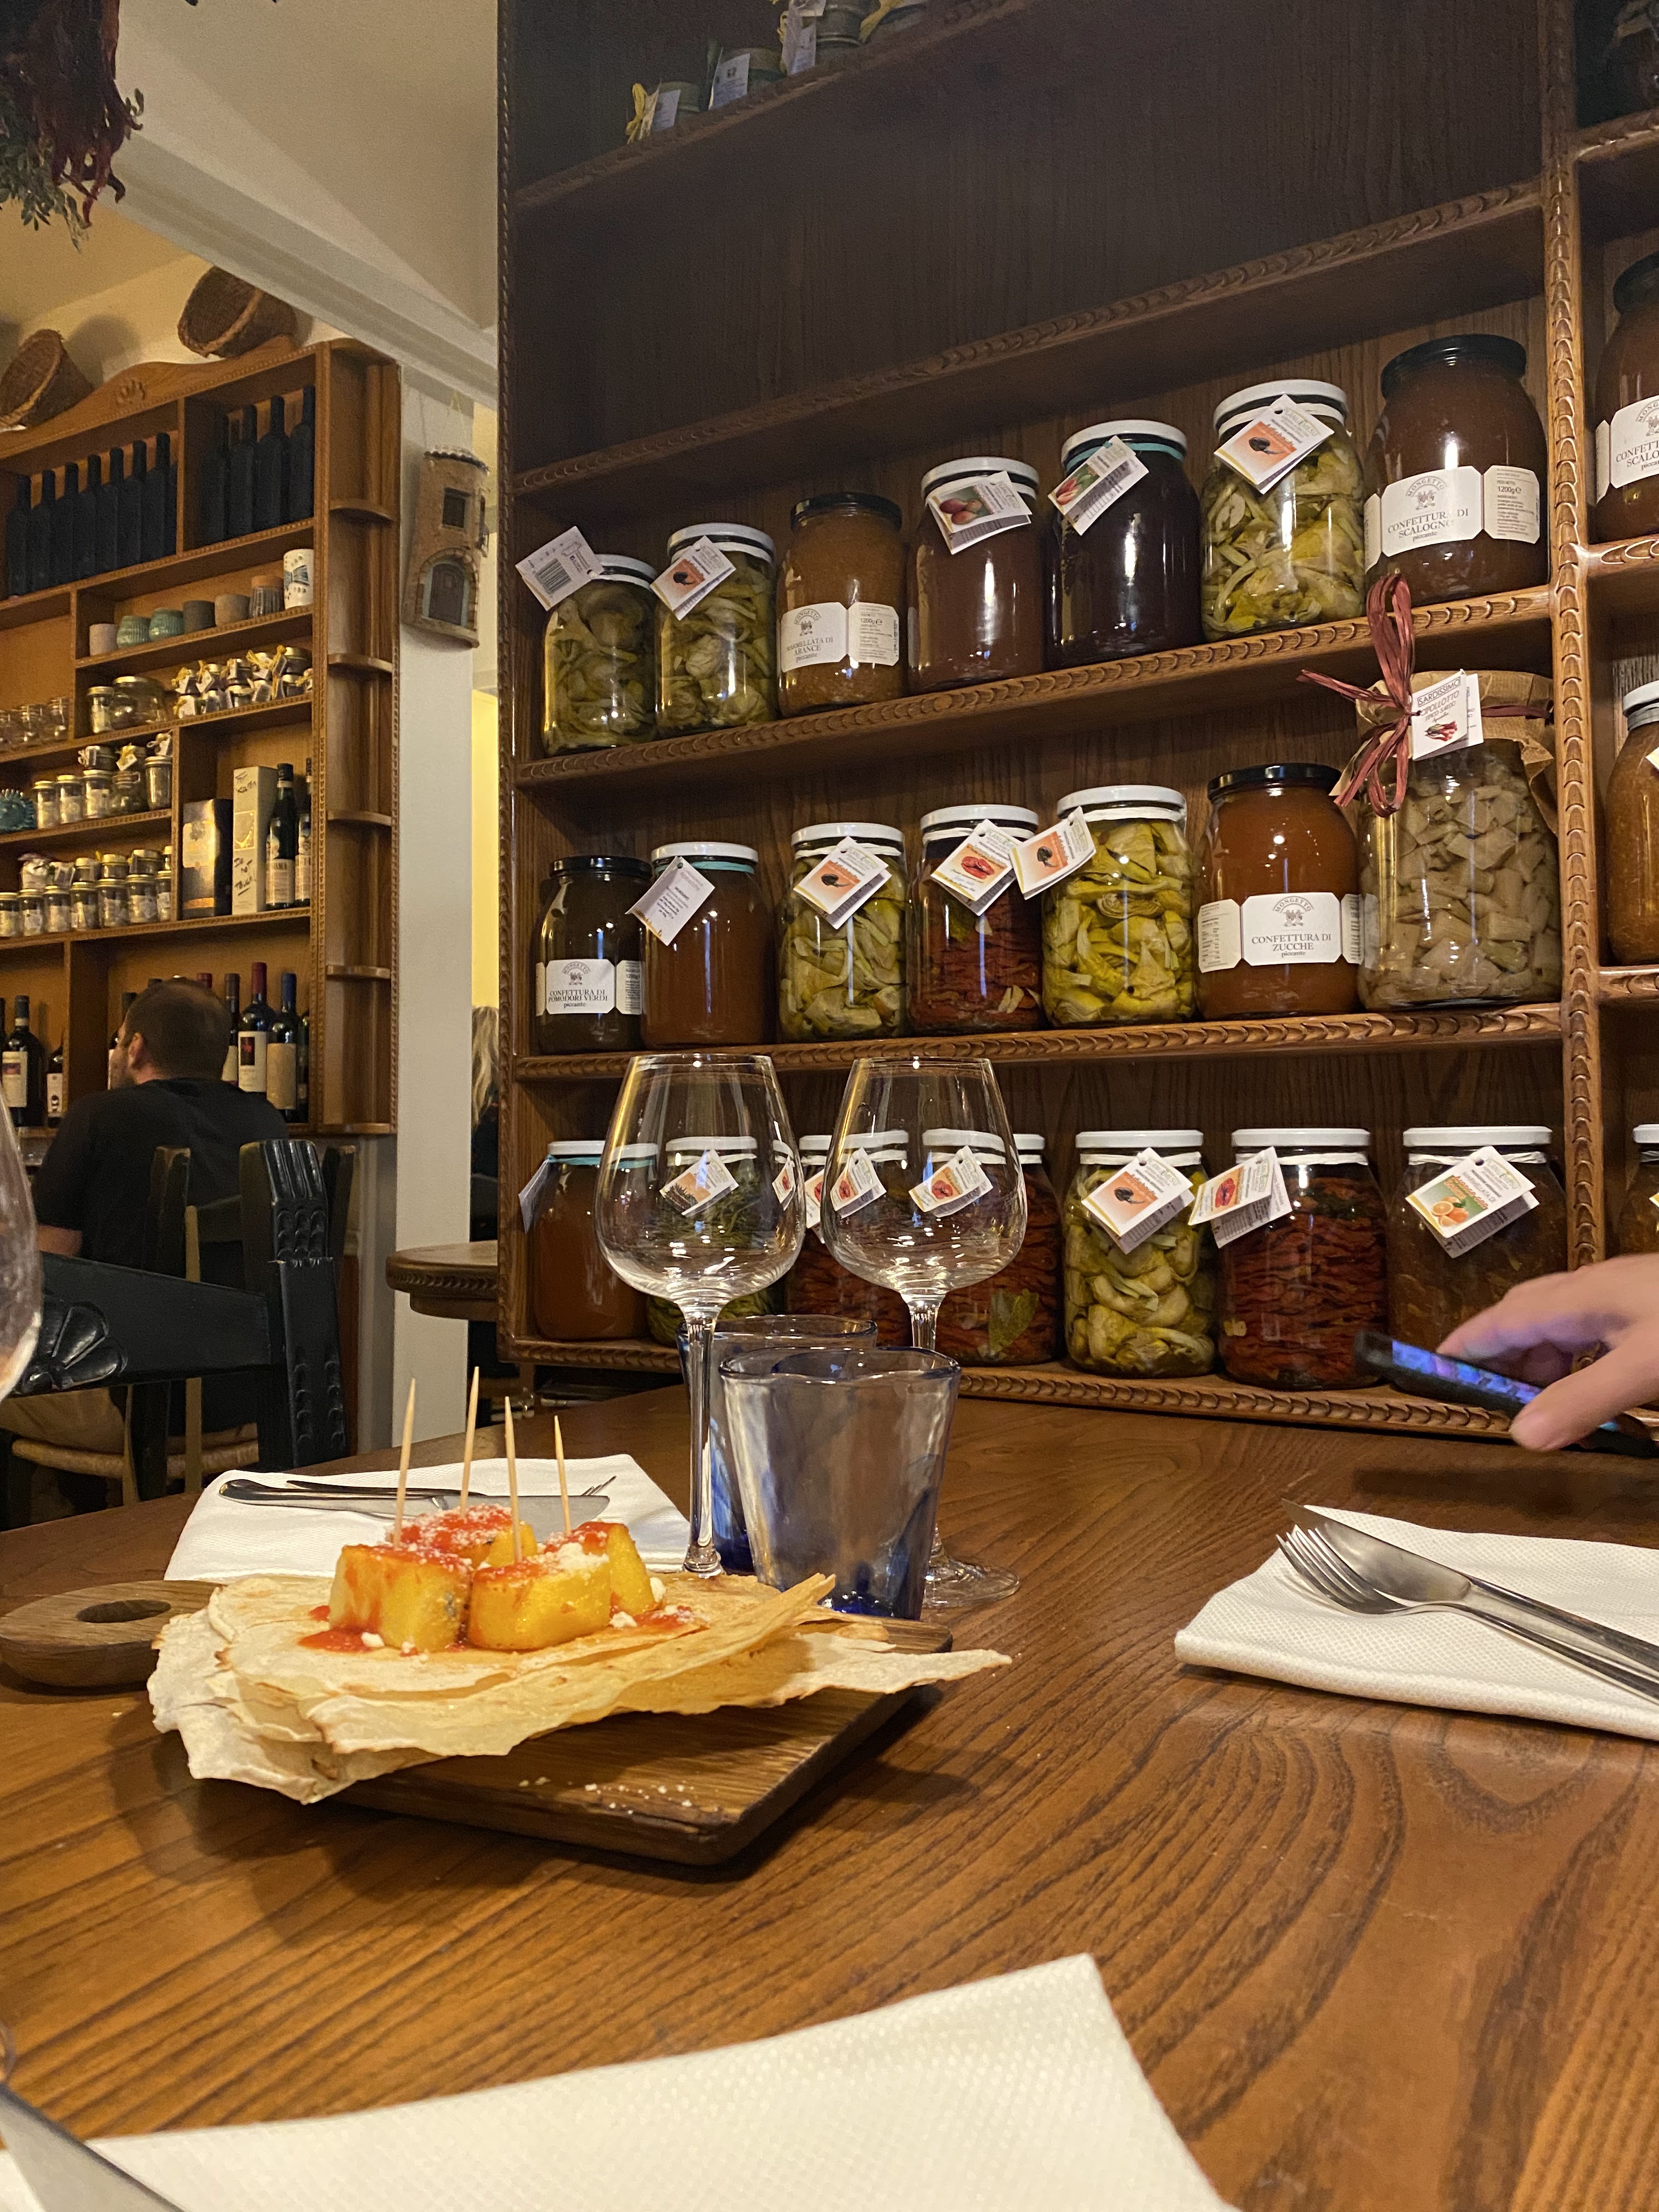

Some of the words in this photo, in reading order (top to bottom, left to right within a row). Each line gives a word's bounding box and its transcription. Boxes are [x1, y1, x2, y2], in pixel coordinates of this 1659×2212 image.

[1408, 477, 1444, 496] MONGETTO
[1498, 486, 1515, 494] 1200g
[1388, 511, 1449, 533] CONFETTUR
[1457, 508, 1469, 517] DI
[1413, 531, 1437, 542] piccante
[795, 609, 819, 624] MONGETTO
[795, 645, 821, 656] ARANCE
[1418, 679, 1460, 706] SARDISSIMO
[1440, 701, 1456, 714] SARDO
[1275, 897, 1311, 913] MONGETTO
[1251, 933, 1320, 944] CONFETTURA
[1321, 933, 1331, 941] DI
[1272, 942, 1314, 951] ZUCCHE
